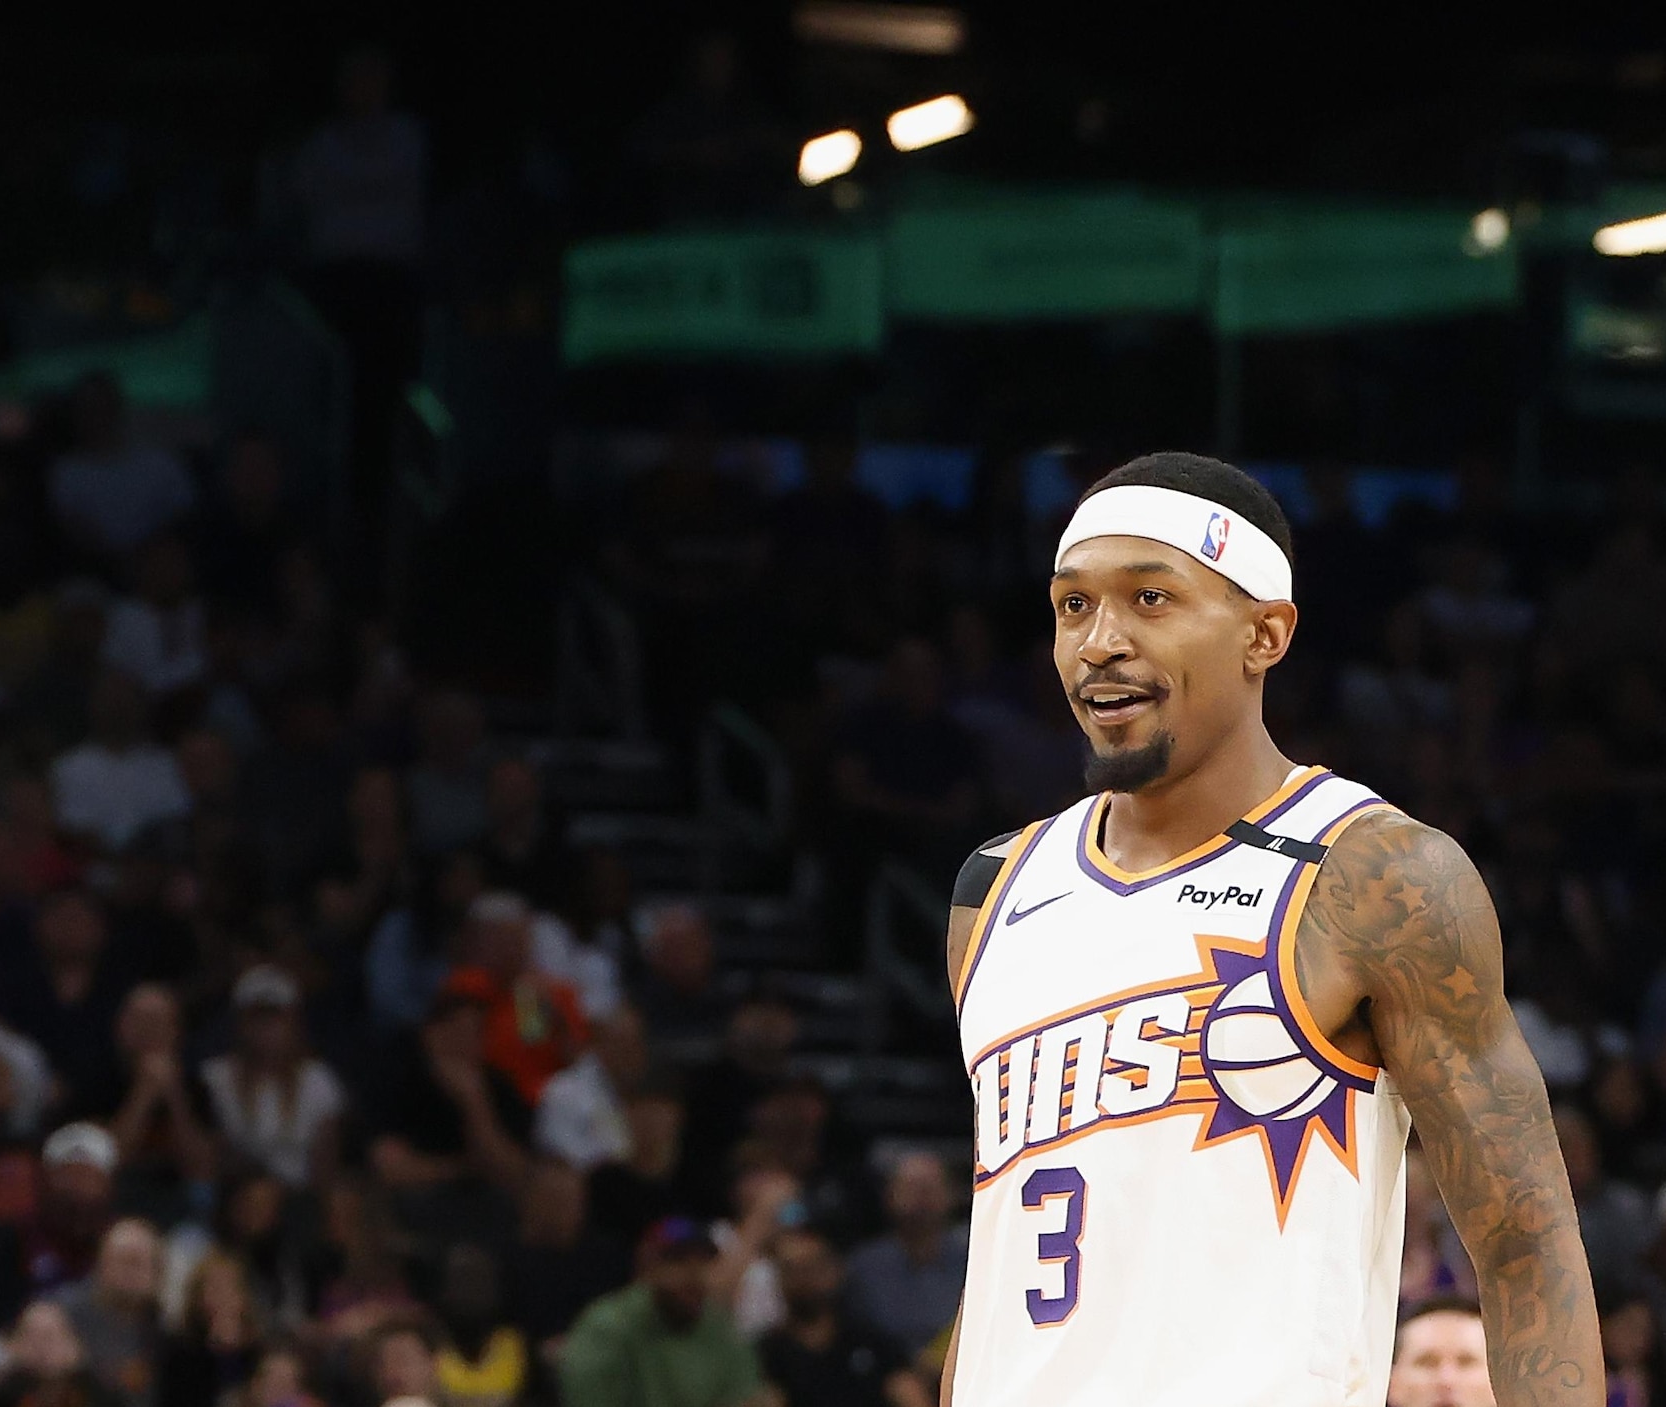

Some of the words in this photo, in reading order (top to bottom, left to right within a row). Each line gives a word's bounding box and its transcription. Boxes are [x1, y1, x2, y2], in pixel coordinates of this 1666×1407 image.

[1177, 884, 1263, 910] PayPal
[973, 992, 1191, 1172] UNS
[1021, 1167, 1088, 1329] 3
